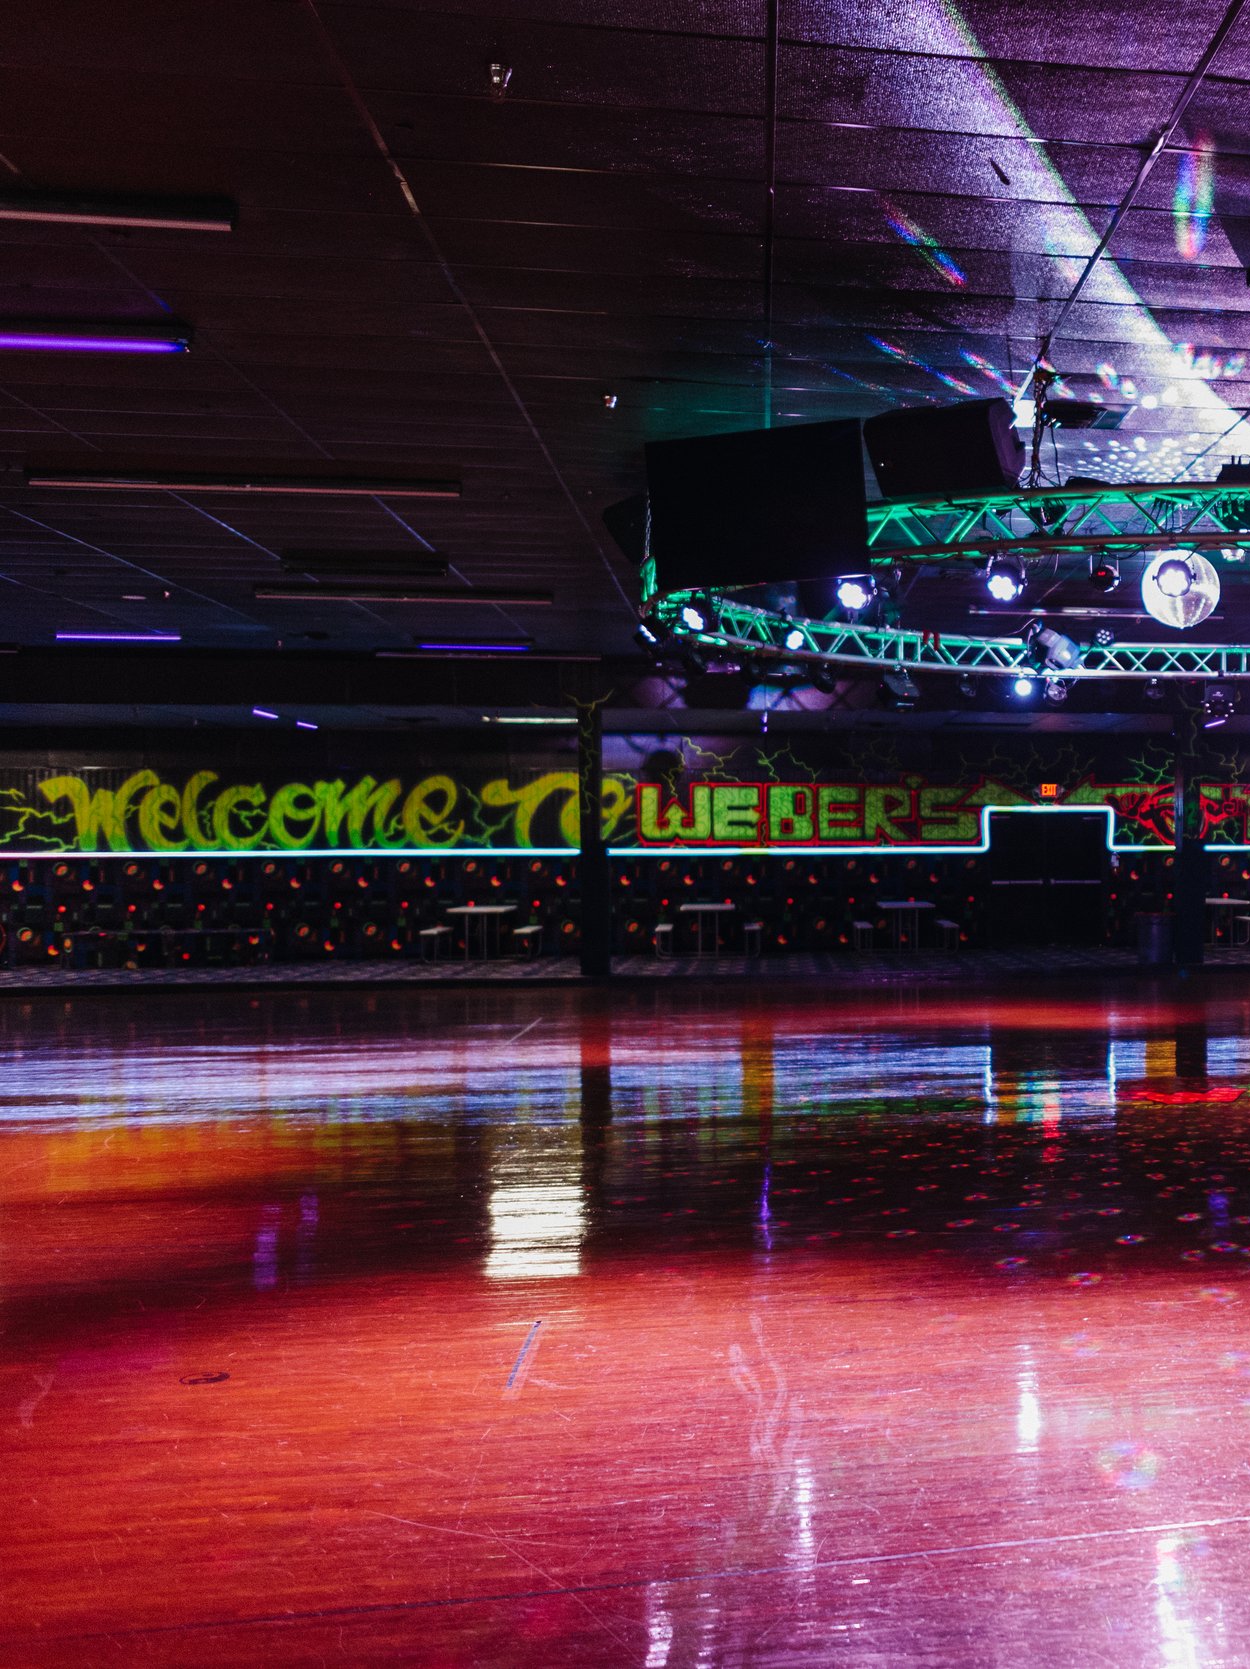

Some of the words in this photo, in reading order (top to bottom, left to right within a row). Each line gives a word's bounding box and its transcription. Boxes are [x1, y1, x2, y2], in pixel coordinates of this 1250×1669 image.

[38, 769, 464, 851] Welcome
[637, 774, 983, 846] WEBER'S
[1041, 783, 1057, 796] EXIT
